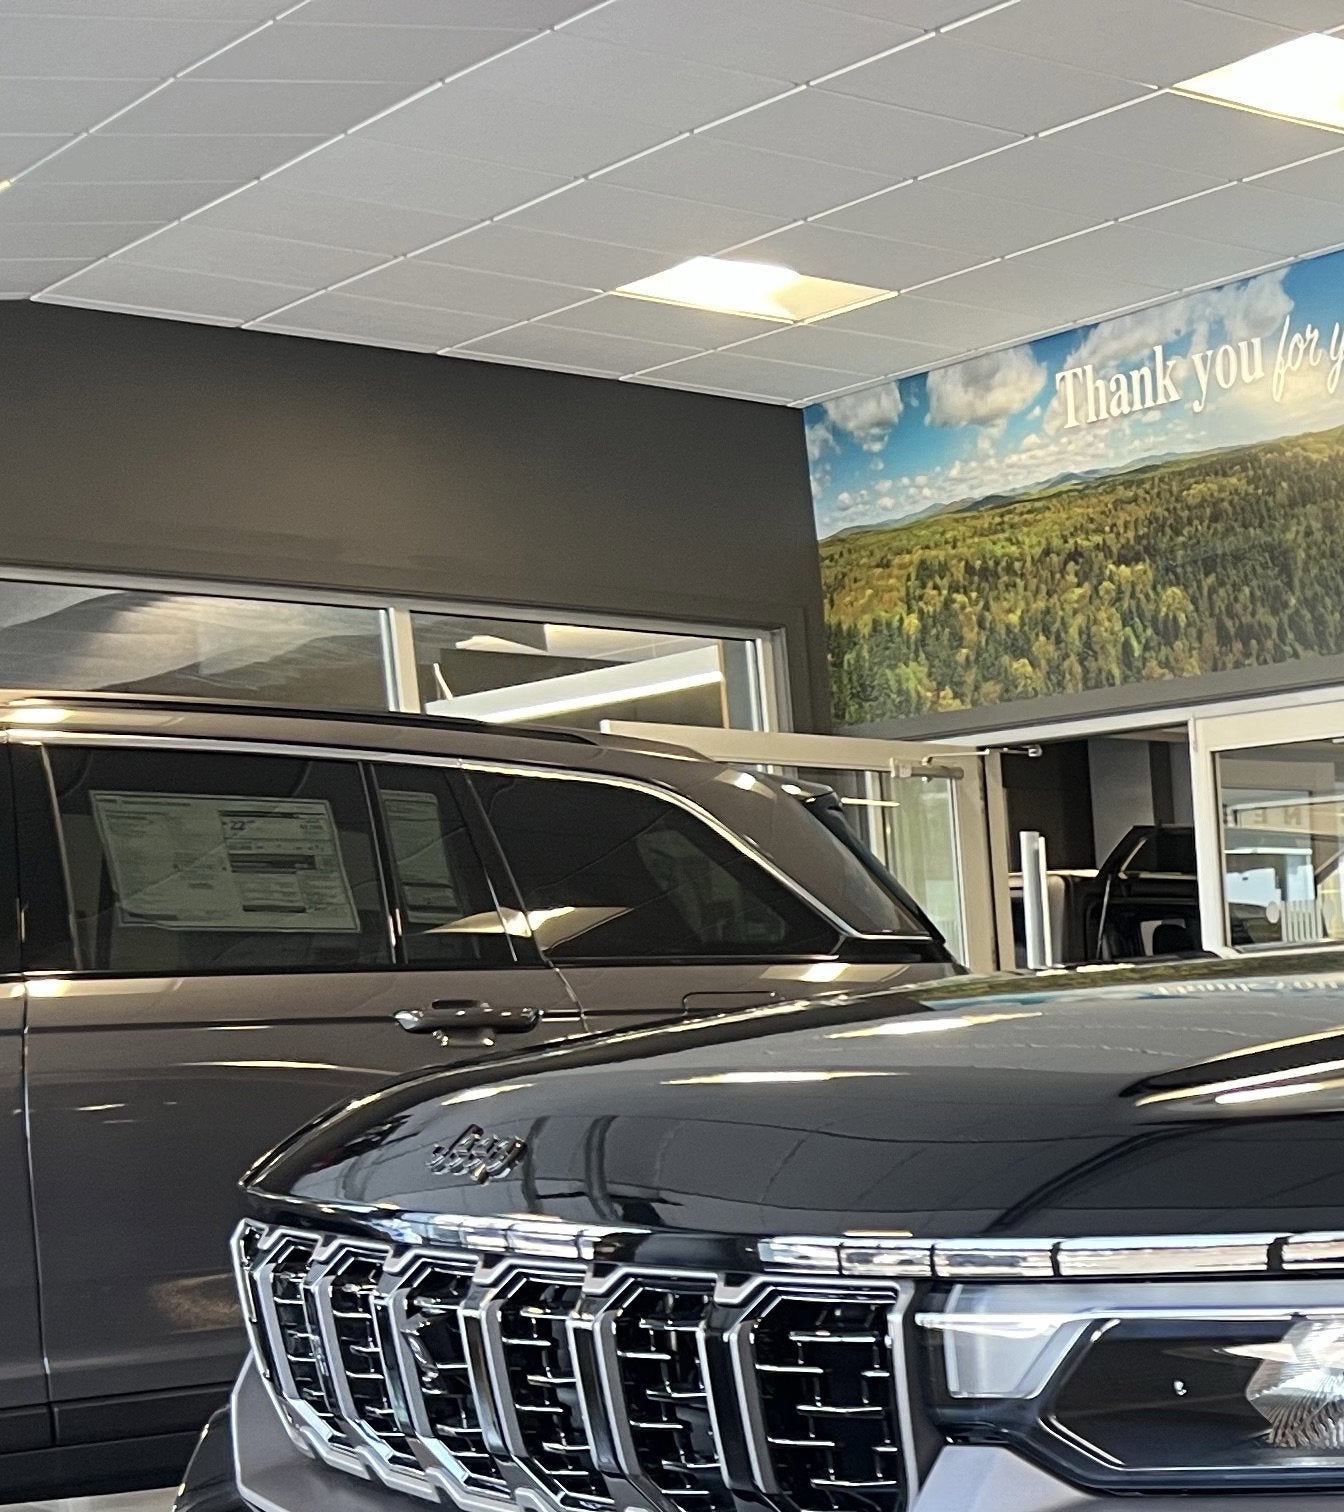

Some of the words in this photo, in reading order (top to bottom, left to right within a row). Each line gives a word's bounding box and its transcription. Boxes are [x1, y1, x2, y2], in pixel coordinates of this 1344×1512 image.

[1055, 344, 1181, 430] Thank
[1191, 335, 1266, 413] you
[1271, 316, 1322, 402] for
